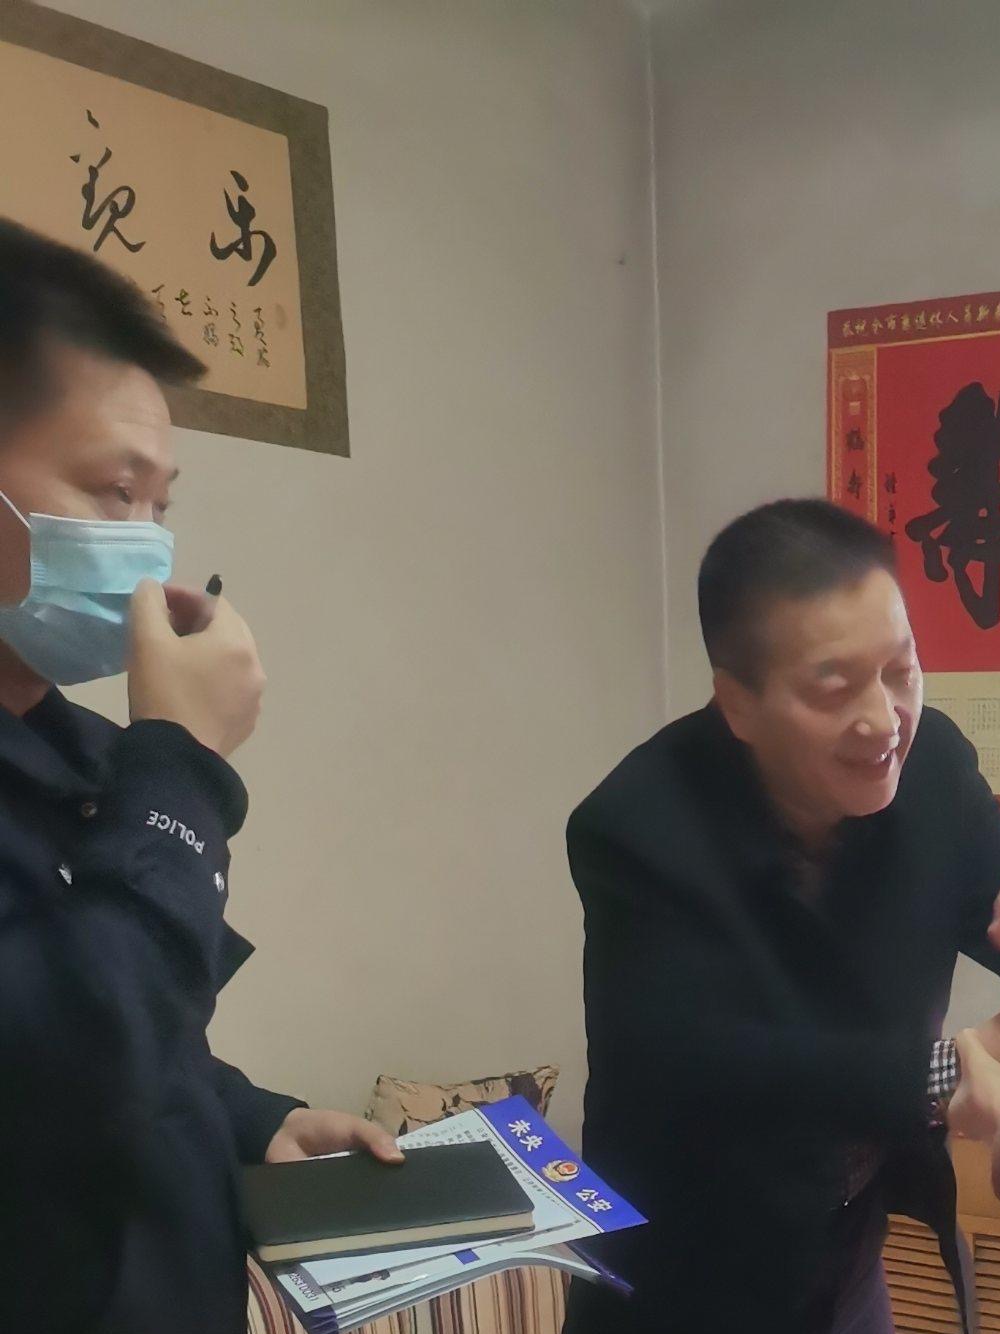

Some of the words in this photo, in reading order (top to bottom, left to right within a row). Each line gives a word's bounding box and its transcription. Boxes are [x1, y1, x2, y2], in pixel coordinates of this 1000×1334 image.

[146, 809, 206, 855] POLICE
[508, 1119, 543, 1152] 未央
[576, 1188, 613, 1213] 公安
